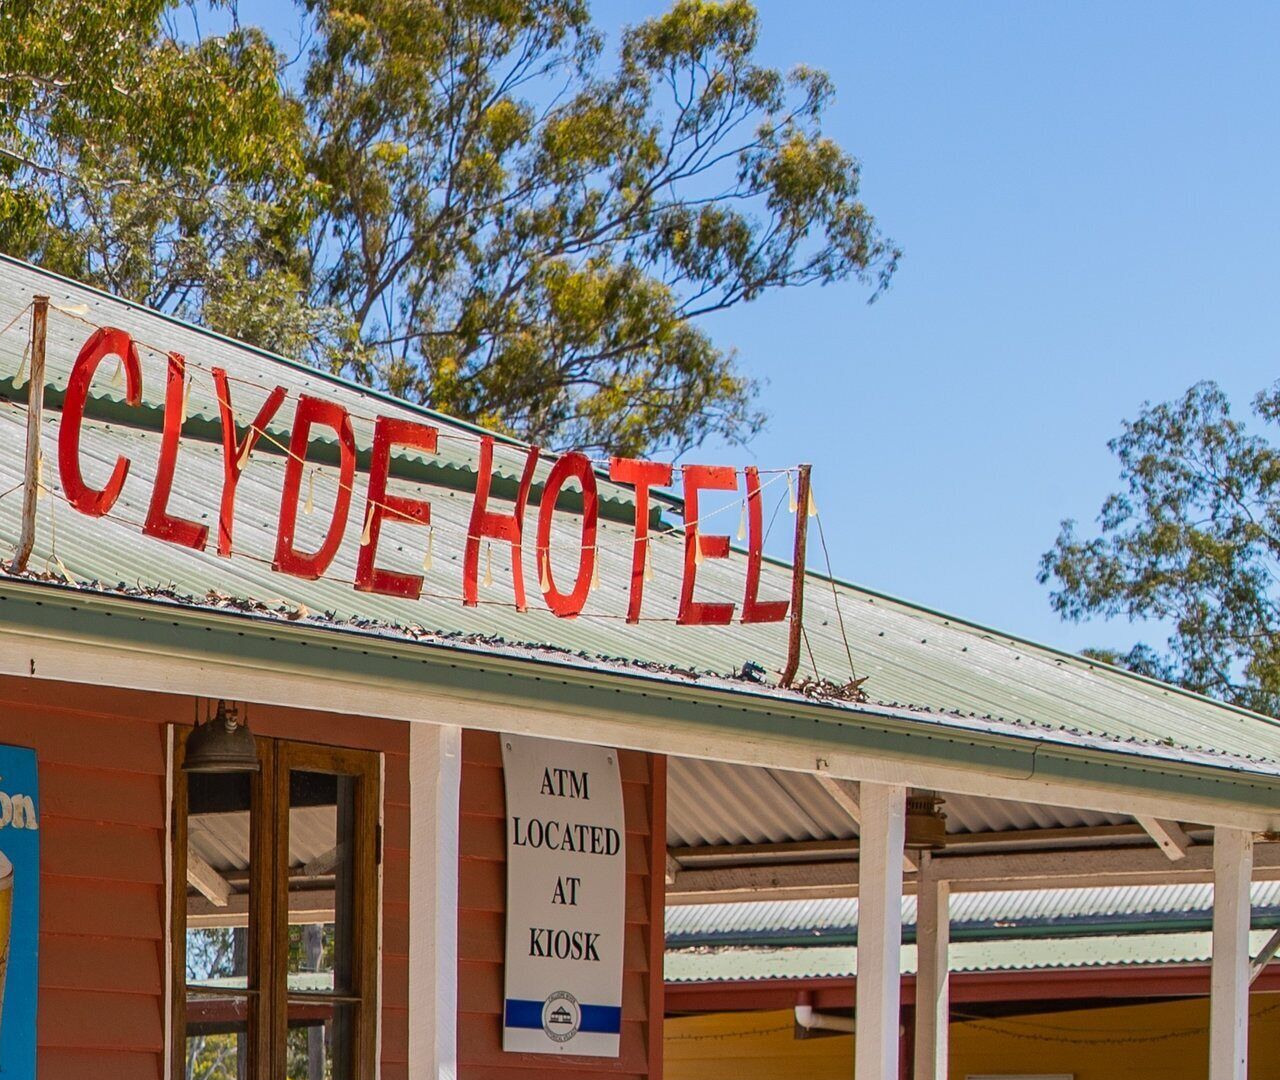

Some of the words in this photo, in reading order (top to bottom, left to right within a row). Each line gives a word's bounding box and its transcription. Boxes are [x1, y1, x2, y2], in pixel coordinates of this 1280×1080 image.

[58, 326, 439, 599] CLYDE
[463, 434, 790, 625] HOTEL
[540, 767, 590, 800] ATM
[512, 816, 620, 856] LOCATED
[551, 875, 581, 906] AT
[528, 927, 601, 961] KIOSK
